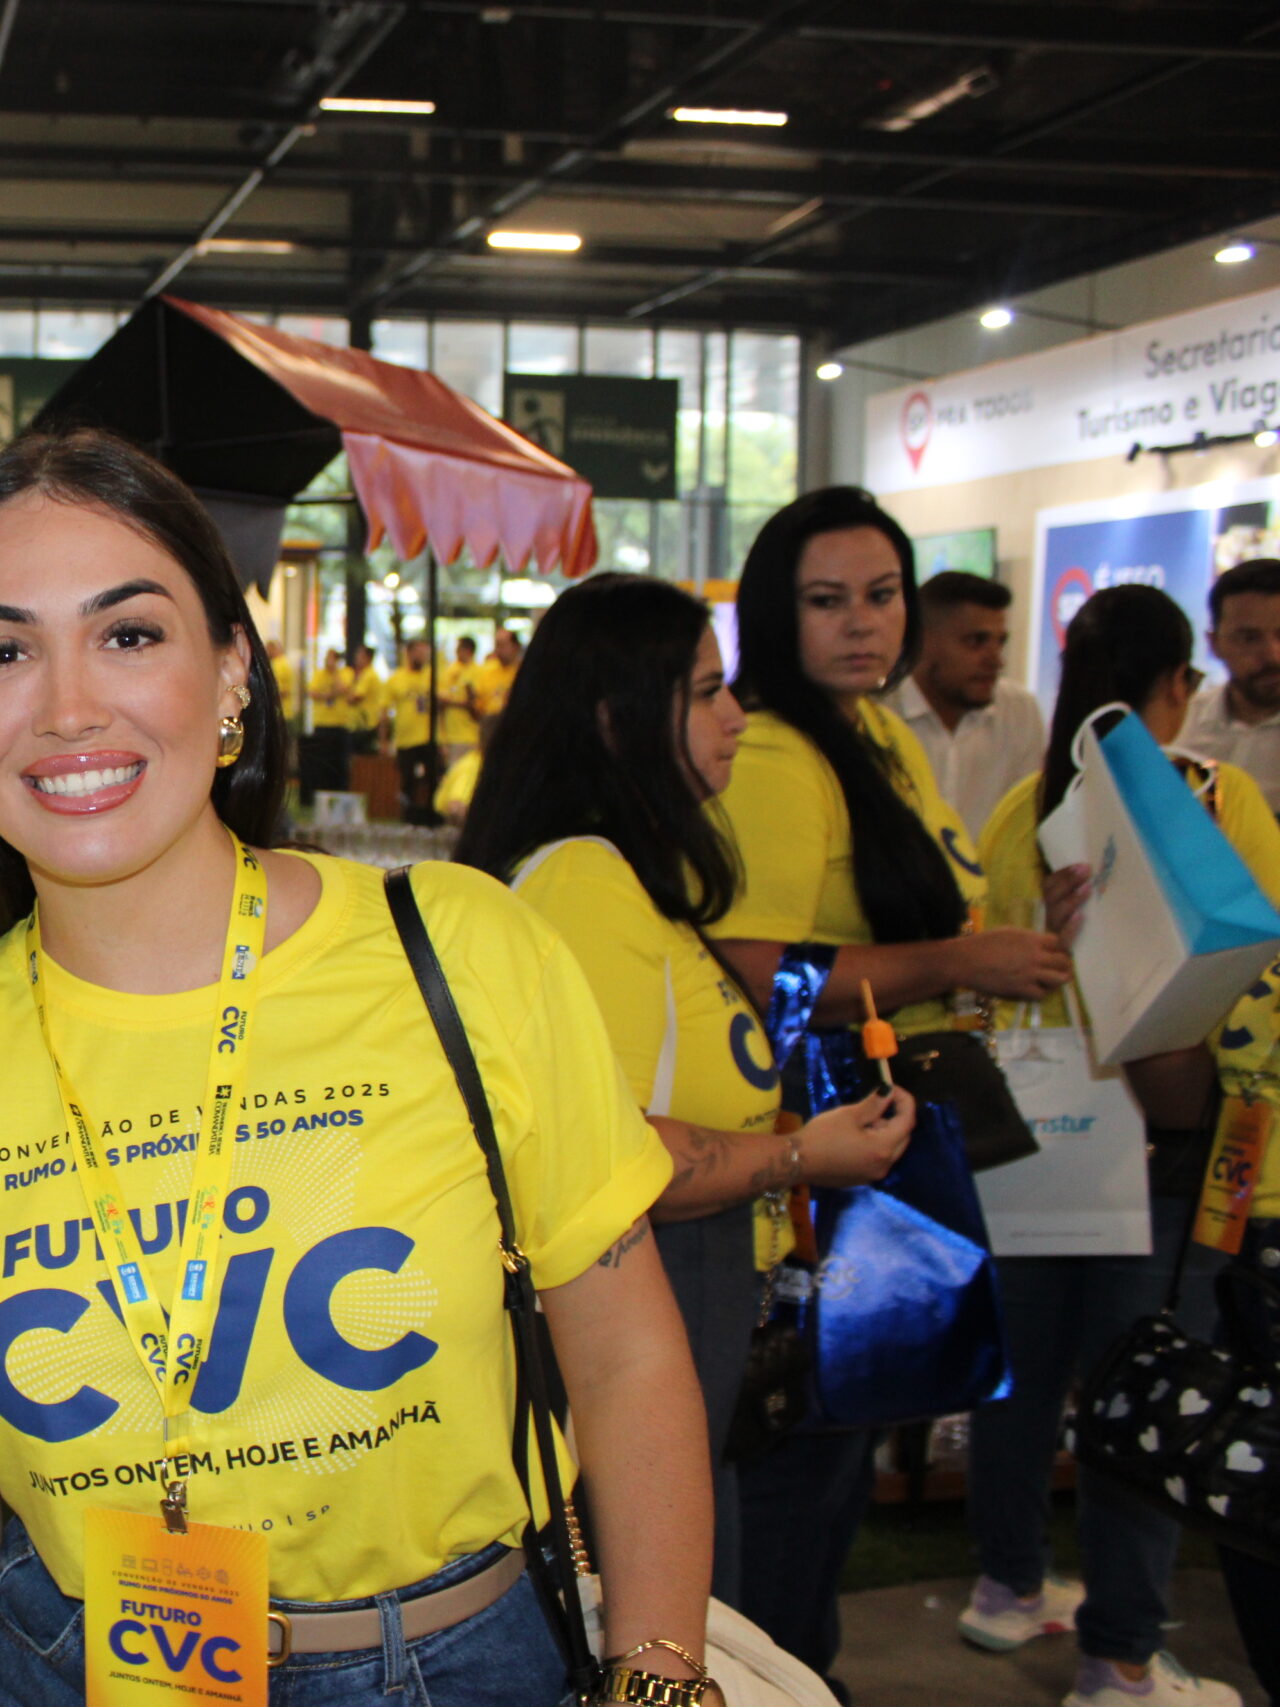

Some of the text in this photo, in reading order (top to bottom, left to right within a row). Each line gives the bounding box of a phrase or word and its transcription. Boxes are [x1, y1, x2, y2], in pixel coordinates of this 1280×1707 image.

[1077, 377, 1280, 440] Turismo e Viag
[217, 1006, 240, 1054] CVC
[238, 1011, 248, 1042] FUTURO
[149, 1109, 181, 1129] DE
[324, 1083, 390, 1101] 2025
[4, 1158, 66, 1192] RUMO
[126, 1124, 251, 1164] PRÓXIS
[256, 1119, 286, 1140] 50
[292, 1109, 364, 1133] ANOS
[174, 1333, 195, 1386] CVC
[30, 1401, 441, 1498] JUNTOS ONTEM, HOJE E AMANHÃ
[121, 1599, 202, 1627] FUTURO
[108, 1619, 243, 1684] CVC
[109, 1670, 141, 1683] JUNTOS
